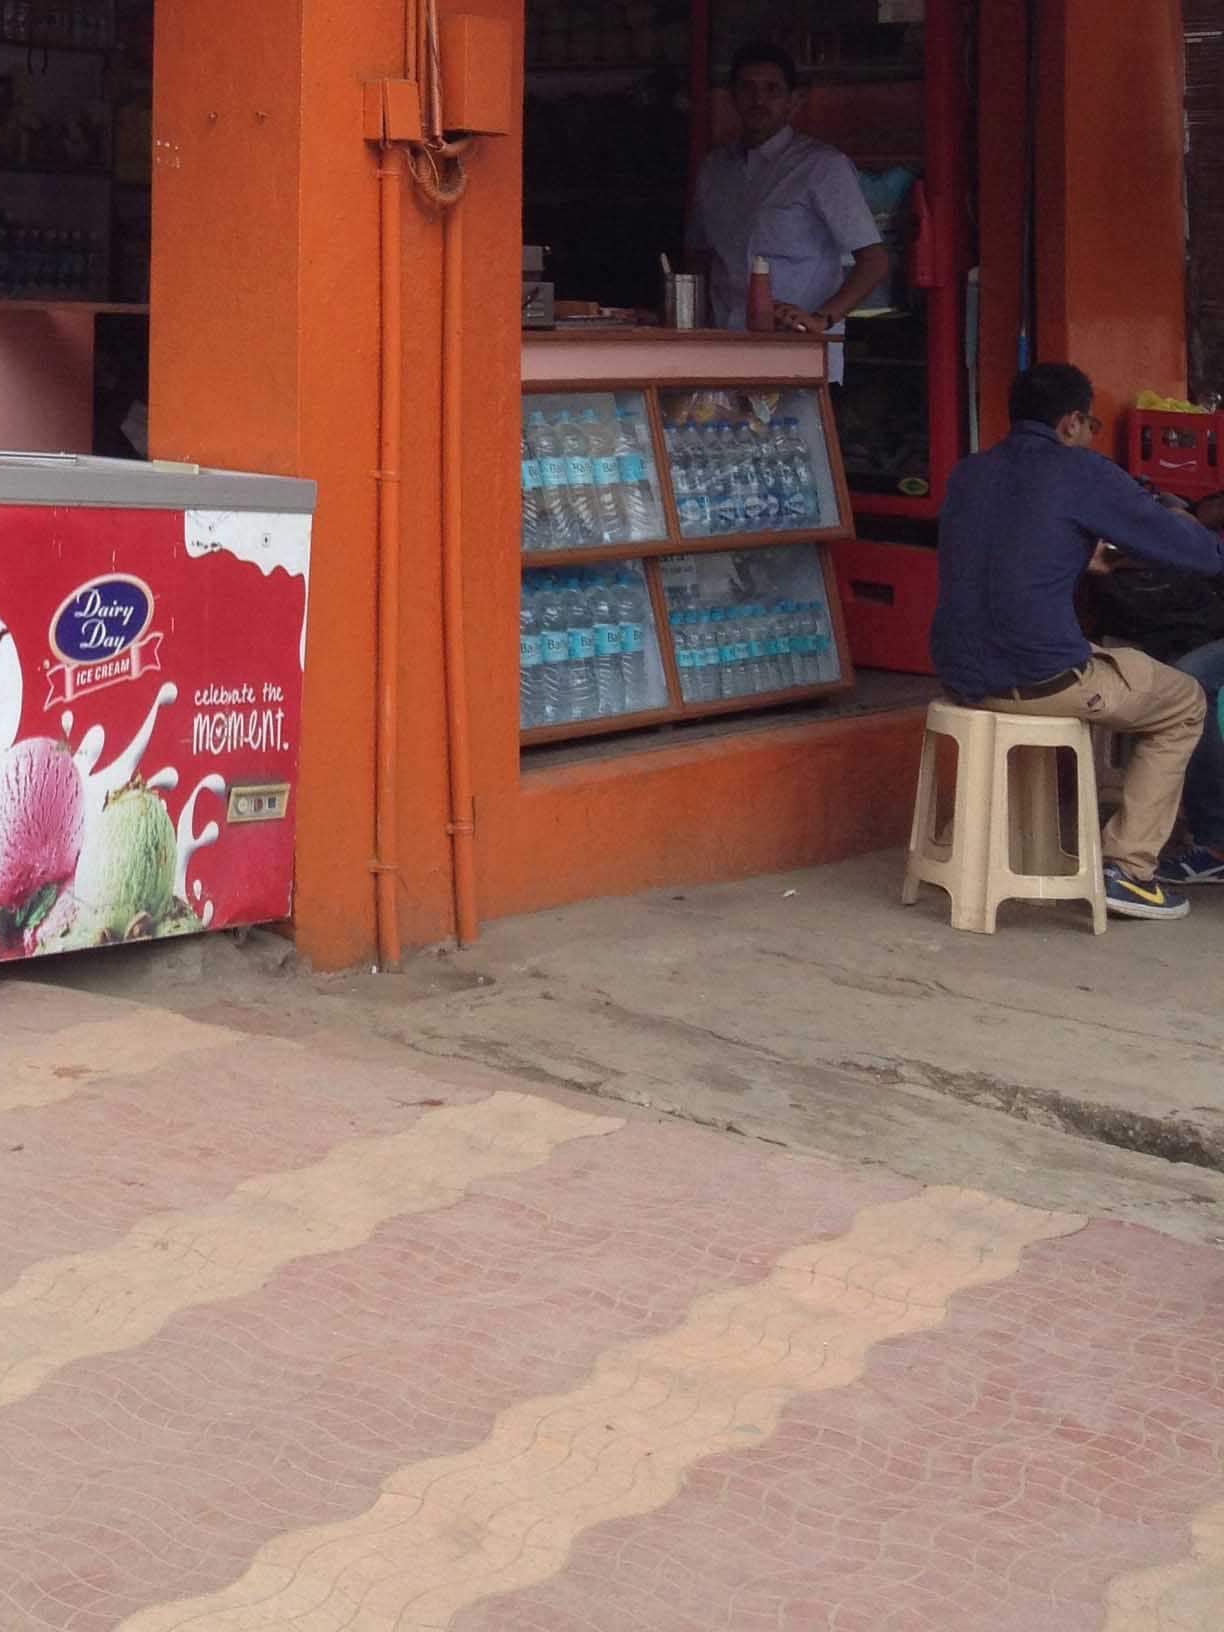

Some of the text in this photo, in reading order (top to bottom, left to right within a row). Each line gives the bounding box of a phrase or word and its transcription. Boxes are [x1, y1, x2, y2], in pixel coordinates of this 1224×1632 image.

[75, 588, 134, 626] Dairy
[79, 619, 125, 655] Day
[76, 658, 130, 686] ICE CREAM
[194, 683, 284, 705] celebrate the
